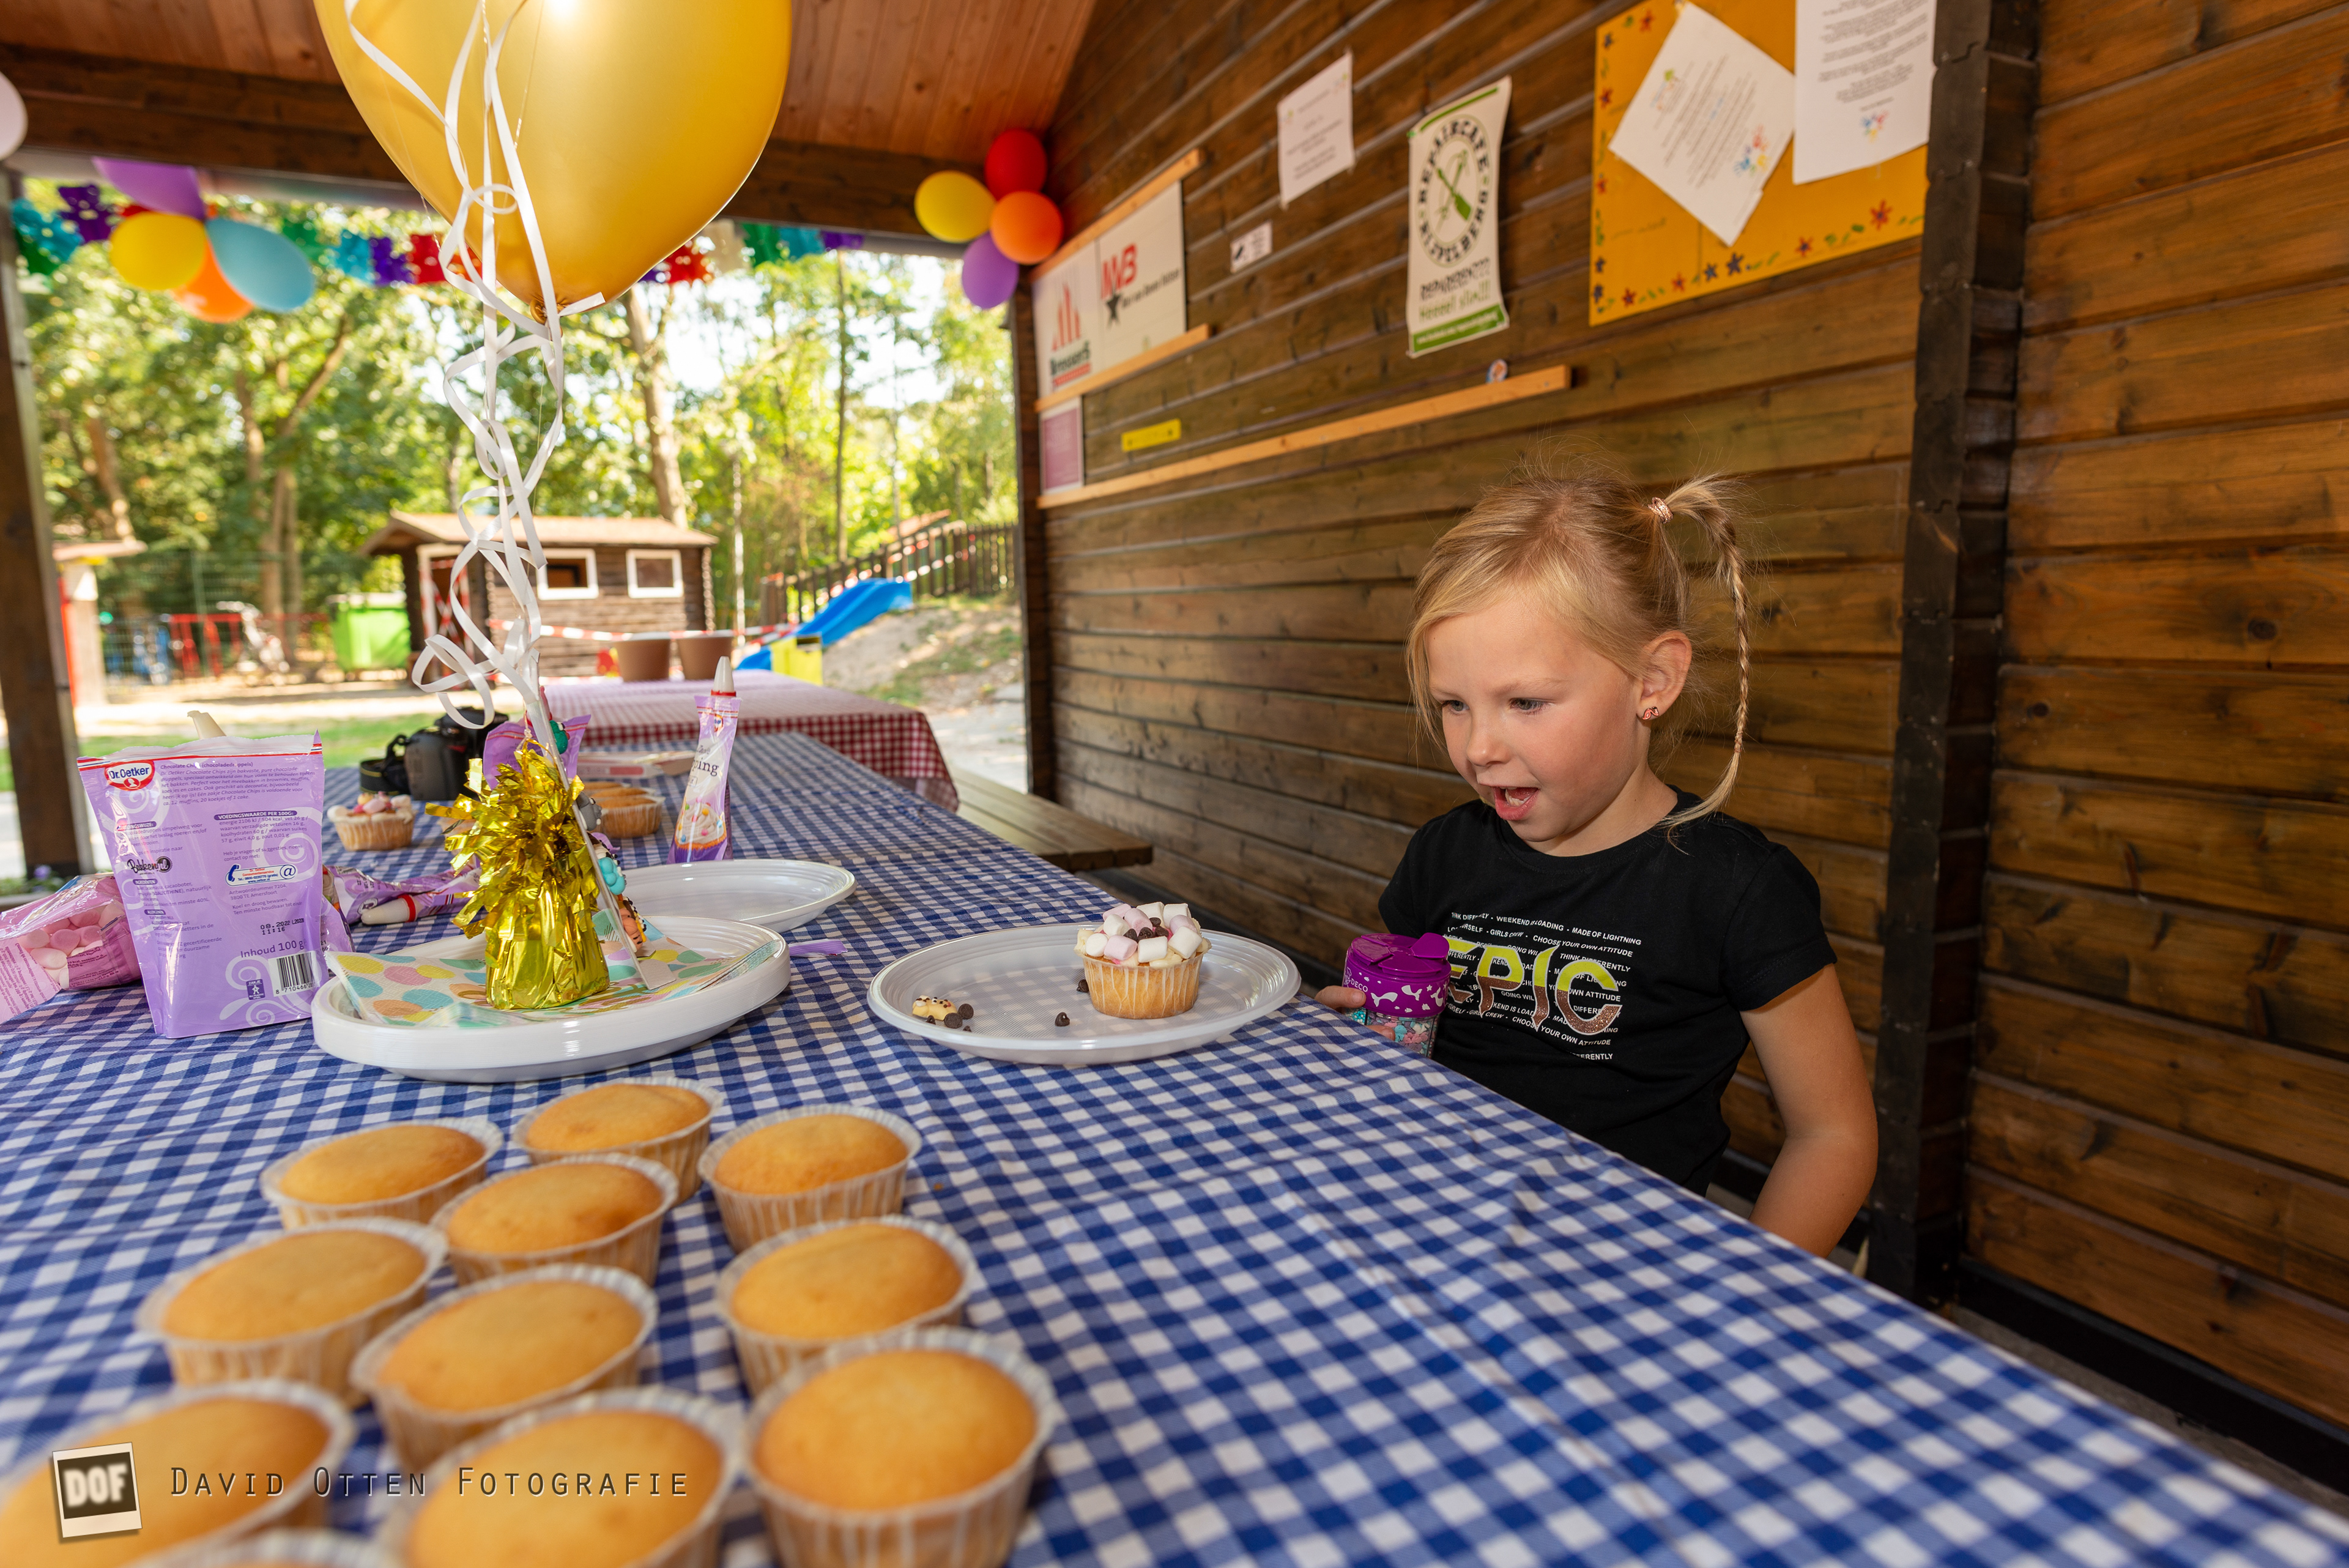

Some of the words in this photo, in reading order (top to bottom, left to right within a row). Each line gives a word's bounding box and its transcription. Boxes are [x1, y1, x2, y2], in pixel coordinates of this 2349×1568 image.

[229, 886, 273, 894] Antwoordnummer
[262, 926, 286, 935] 11:16
[1496, 916, 1529, 926] WEEKEND
[1535, 920, 1564, 931] LOADING
[1572, 927, 1591, 937] MADE
[1603, 933, 1642, 945] LIGHTNING
[184, 937, 222, 946] gecertificeerde
[240, 945, 275, 958] Inhoud
[278, 940, 297, 951] 100
[1490, 929, 1508, 937] GIRLS
[1533, 935, 1561, 946] CHOOSE
[1598, 946, 1633, 957] ATTITUDE
[1351, 978, 1368, 992] DECO
[1442, 935, 1624, 1035] EPIC
[1585, 991, 1621, 1002] ATTITUDE
[1512, 1016, 1537, 1029] CHOOS
[1541, 1026, 1560, 1038] YOUR
[1561, 1034, 1578, 1044] OWN
